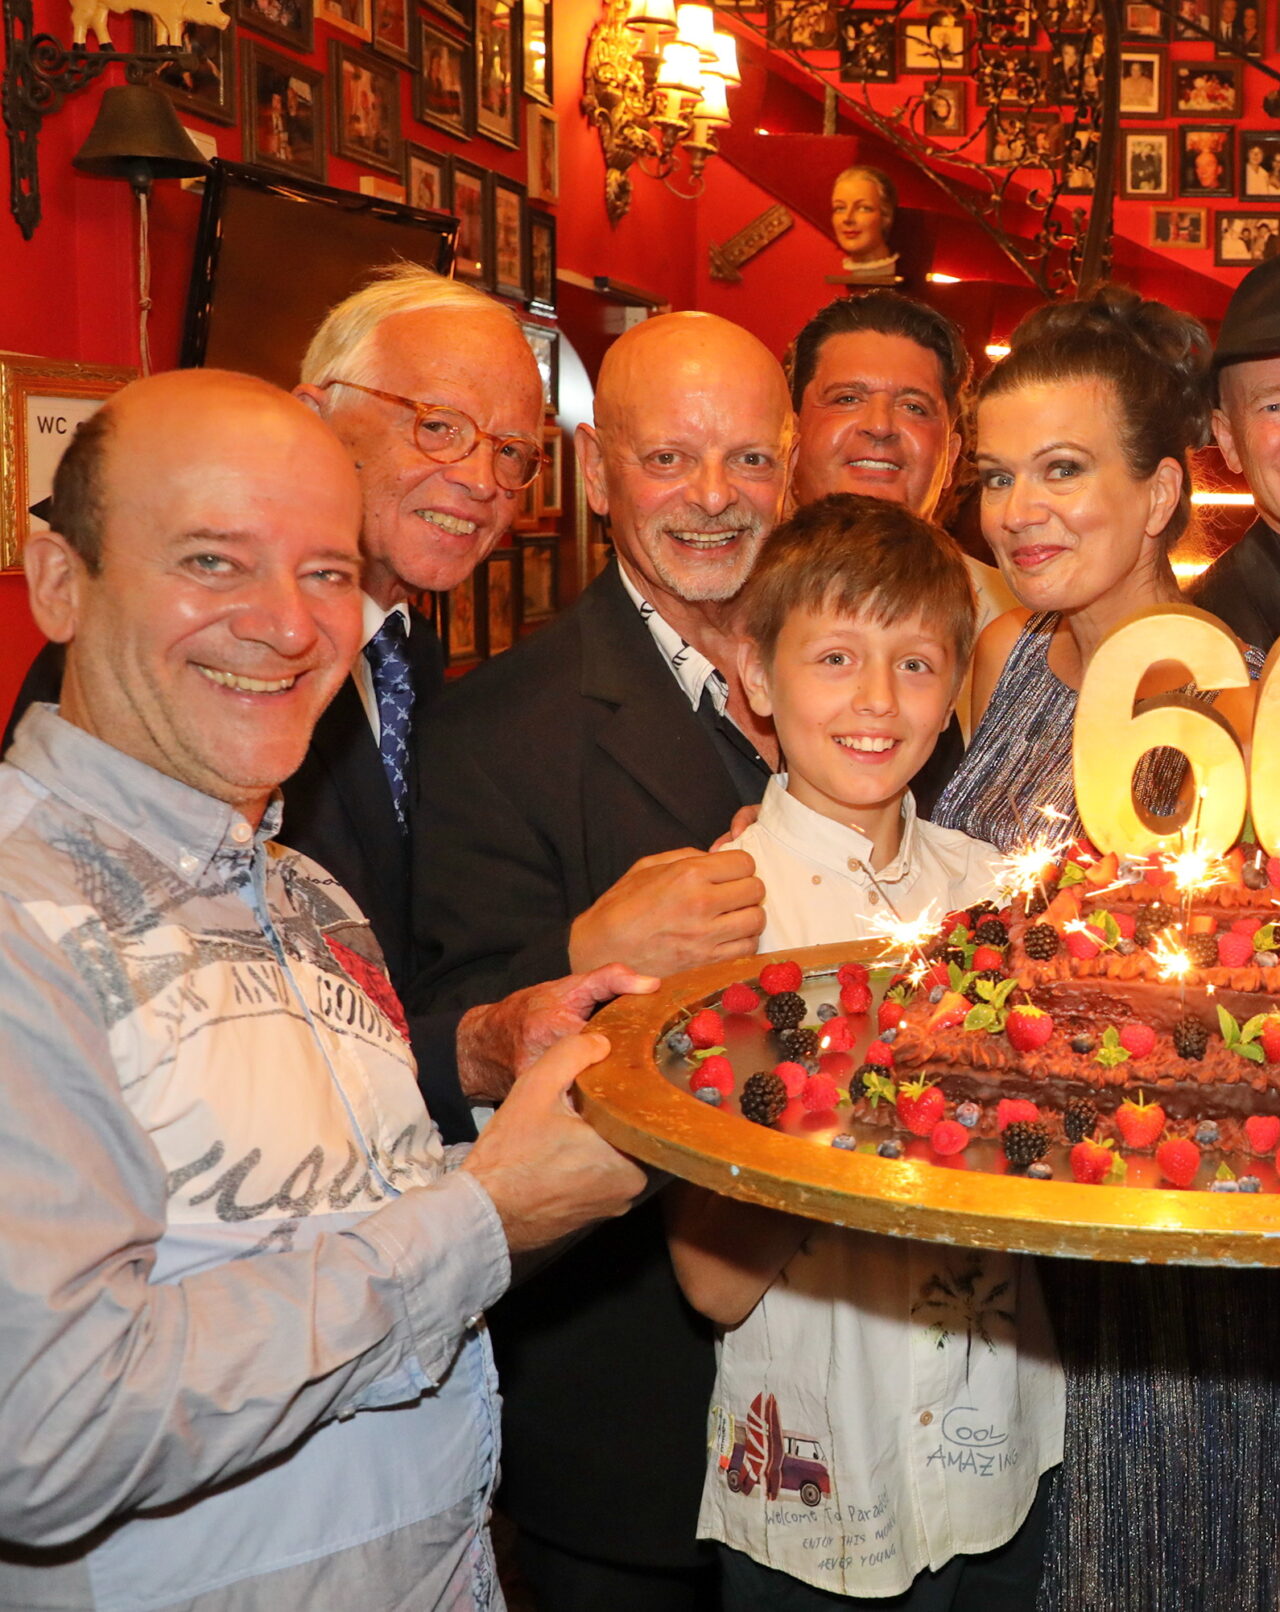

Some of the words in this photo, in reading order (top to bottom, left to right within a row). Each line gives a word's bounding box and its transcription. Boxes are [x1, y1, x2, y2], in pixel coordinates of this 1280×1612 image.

[36, 415, 68, 435] WC
[926, 1443, 1019, 1477] AMAZING
[766, 1506, 818, 1526] Welcome
